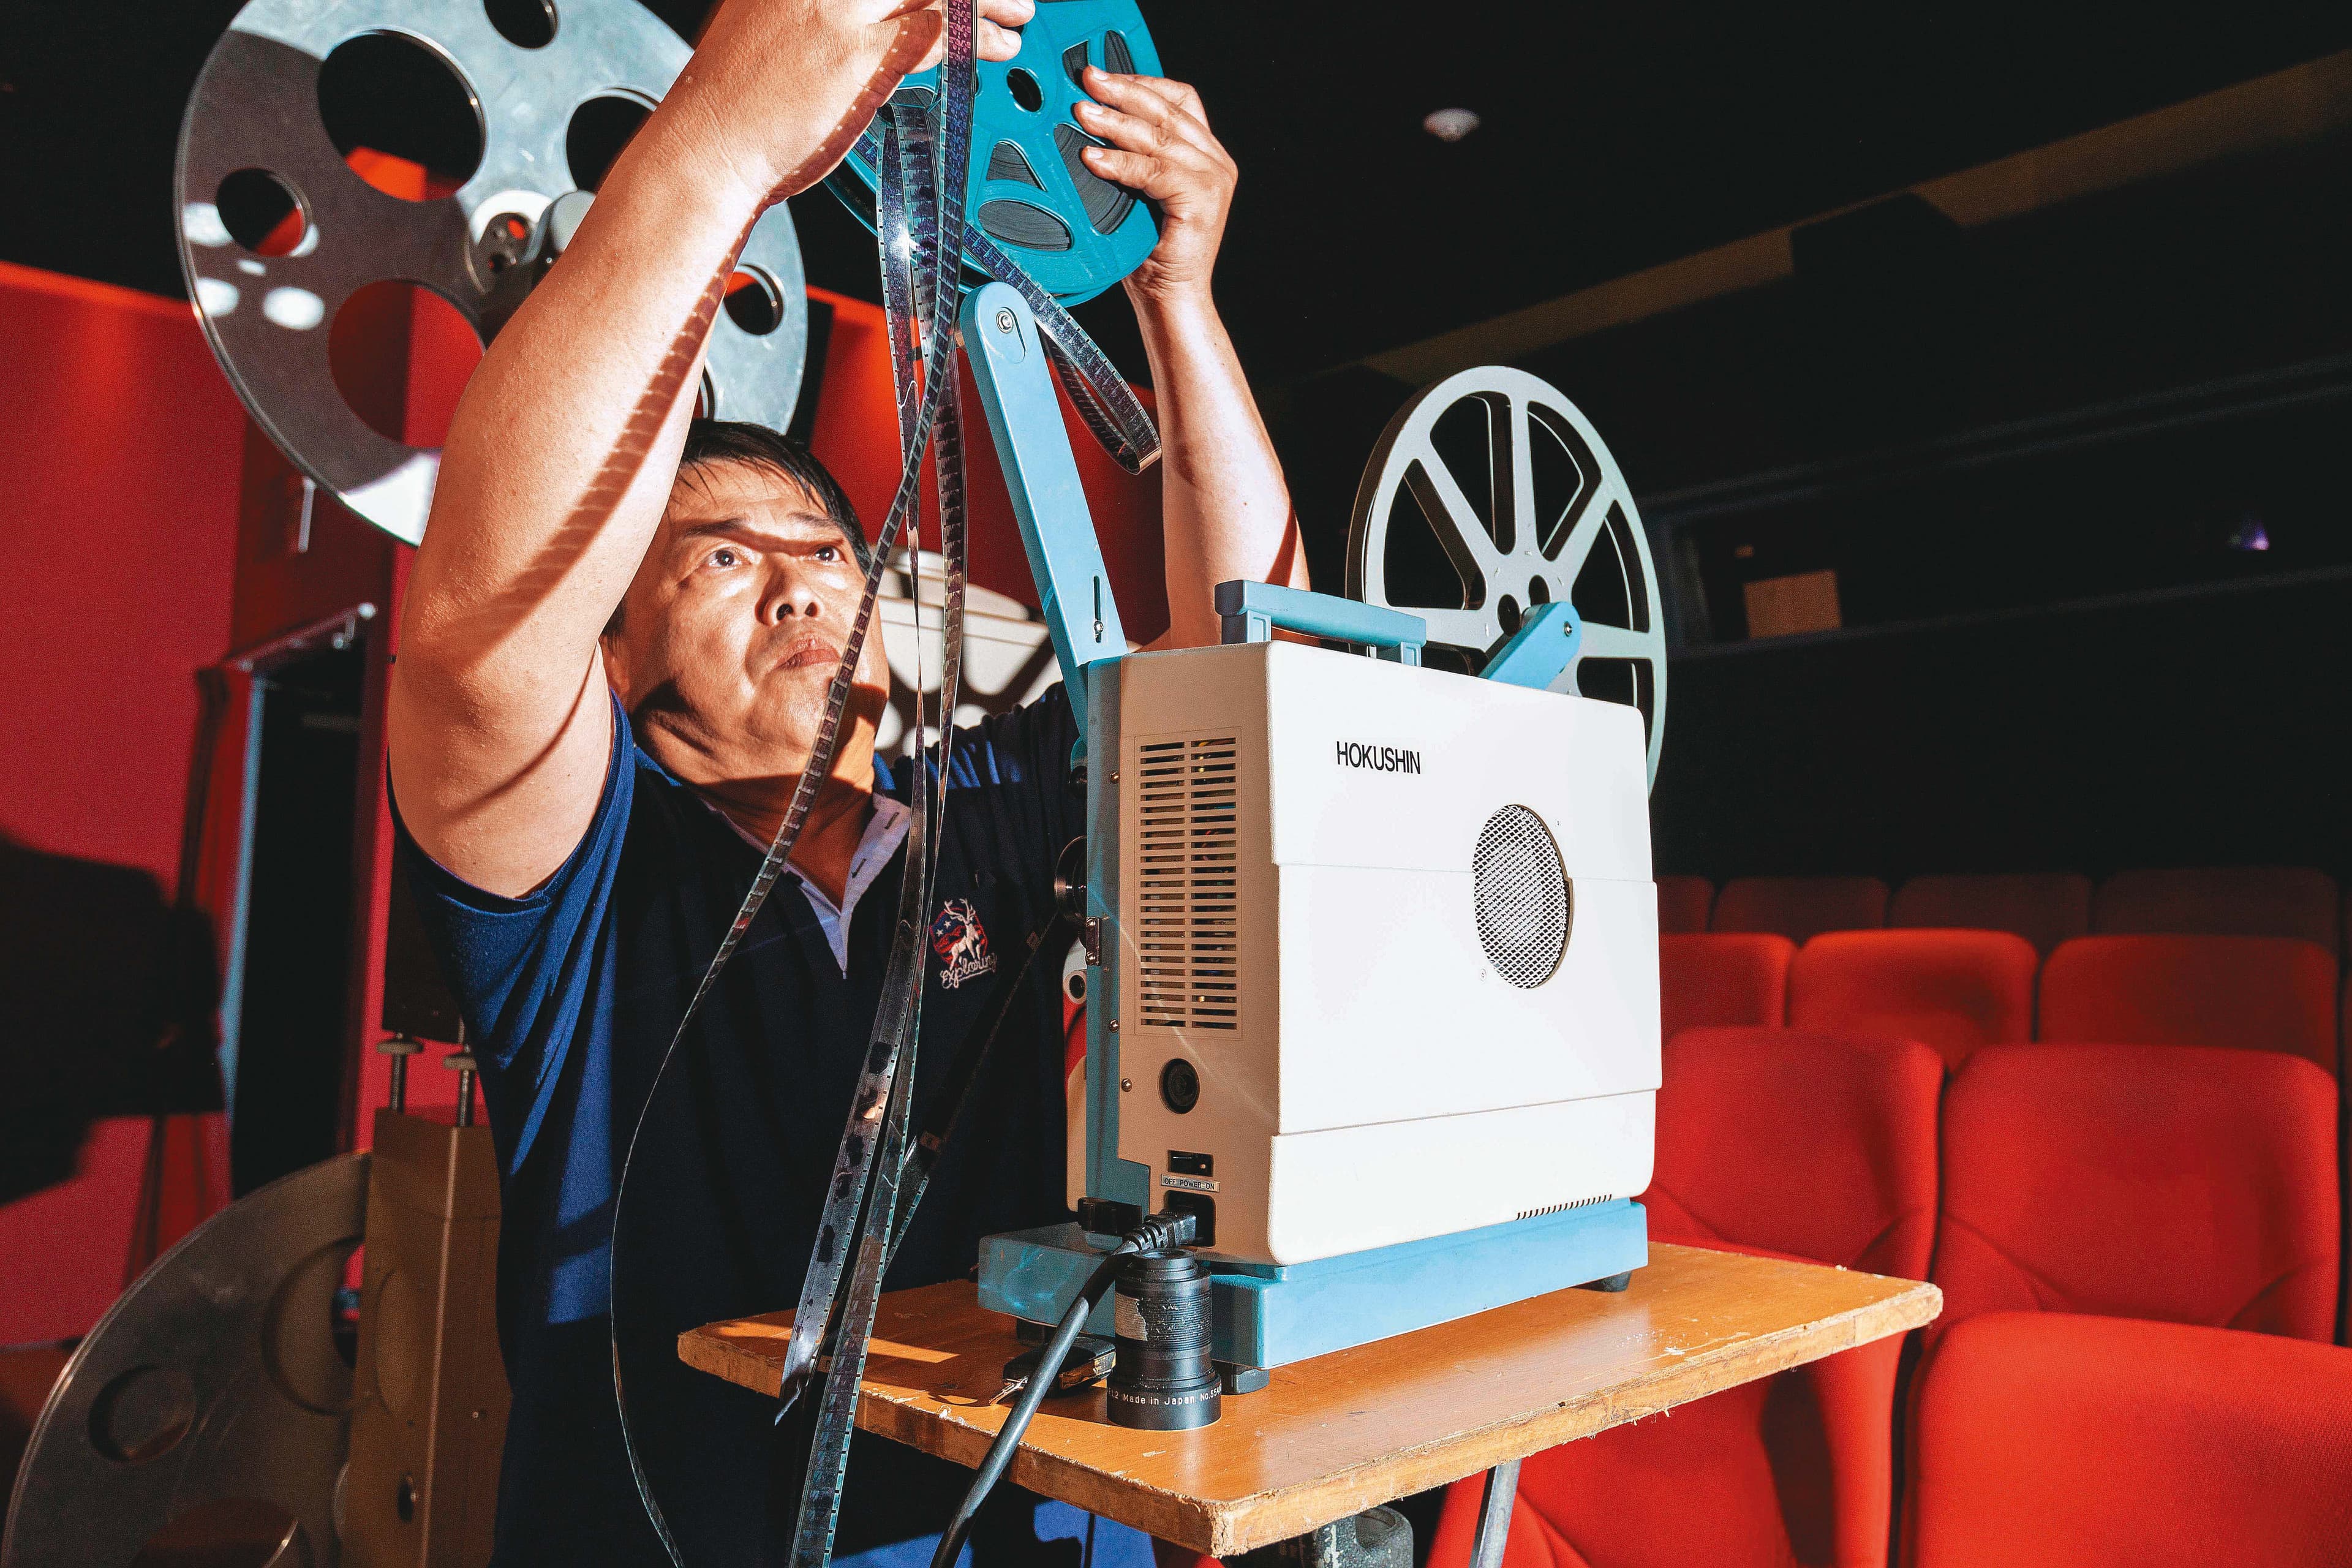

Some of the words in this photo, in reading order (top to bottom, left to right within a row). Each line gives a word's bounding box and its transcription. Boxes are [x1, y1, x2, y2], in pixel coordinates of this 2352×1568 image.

[1336, 741, 1421, 775] HOKUSHIN
[1180, 1179, 1202, 1189] POWER
[1123, 1393, 1146, 1404] Made
[1164, 1395, 1195, 1406] Japan
